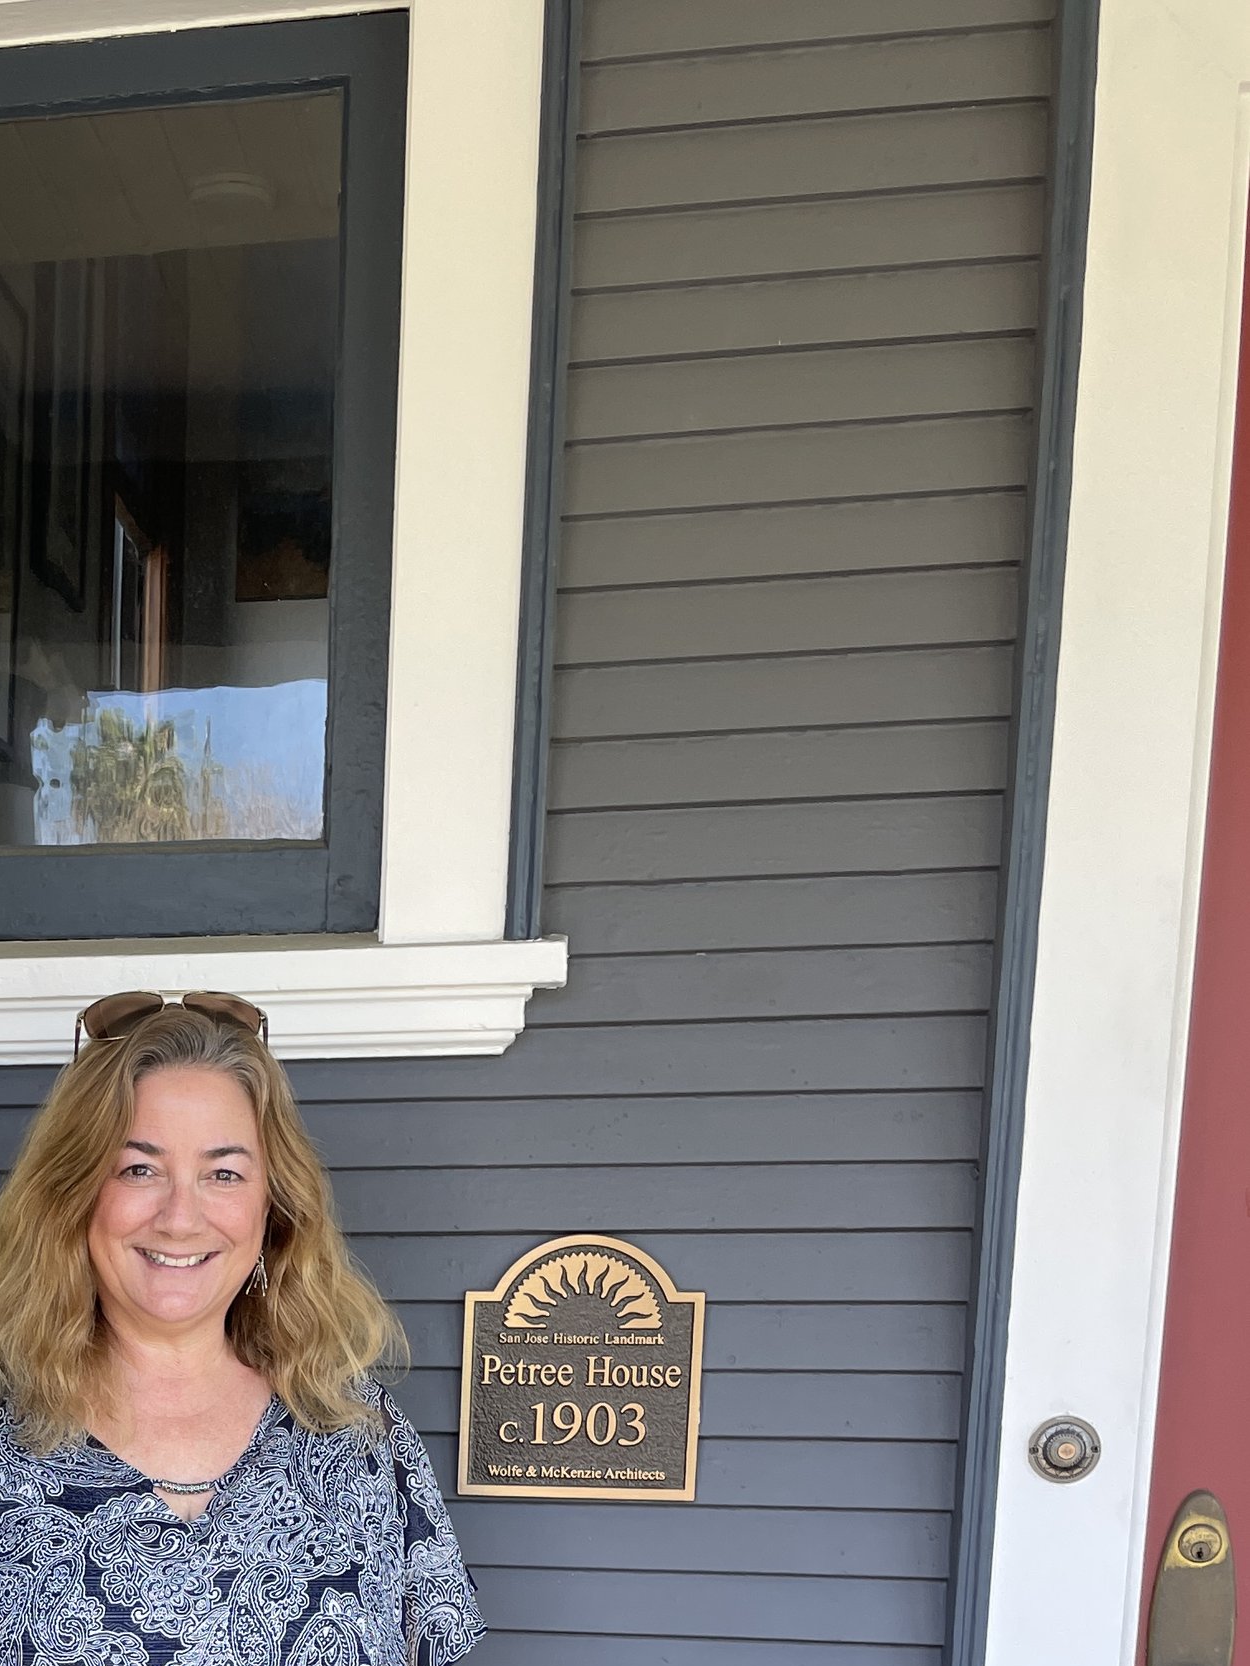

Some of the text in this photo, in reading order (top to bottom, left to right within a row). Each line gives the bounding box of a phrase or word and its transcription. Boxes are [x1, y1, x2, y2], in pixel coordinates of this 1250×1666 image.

[499, 1333, 665, 1345] San Jose Historic Landmark
[481, 1354, 682, 1388] Petree House
[488, 1464, 666, 1481] Wolfe & McKenzie Architects
